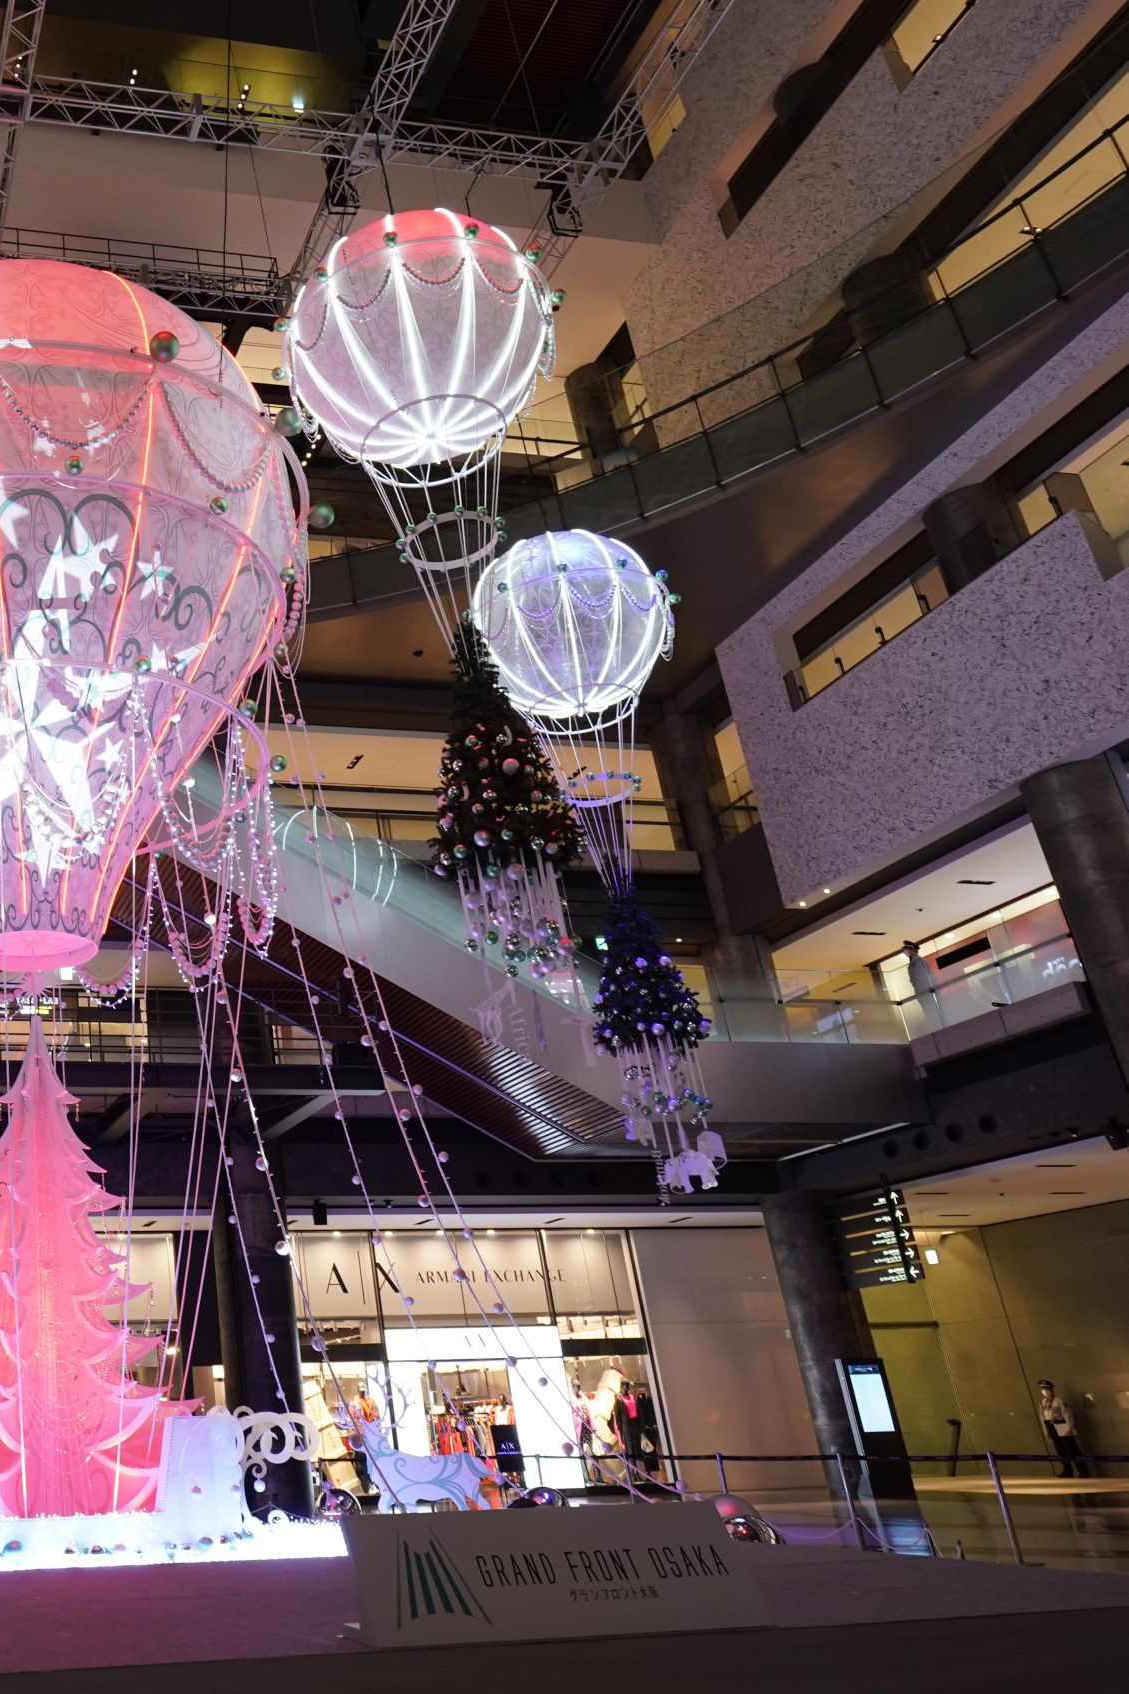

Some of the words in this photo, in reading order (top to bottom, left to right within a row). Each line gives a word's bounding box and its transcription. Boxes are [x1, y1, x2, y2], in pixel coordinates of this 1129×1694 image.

[475, 1552, 557, 1588] GRAND
[564, 1548, 641, 1583] FRONT
[647, 1544, 730, 1579] OSAKA
[569, 1585, 660, 1602] グランフロント大阪
